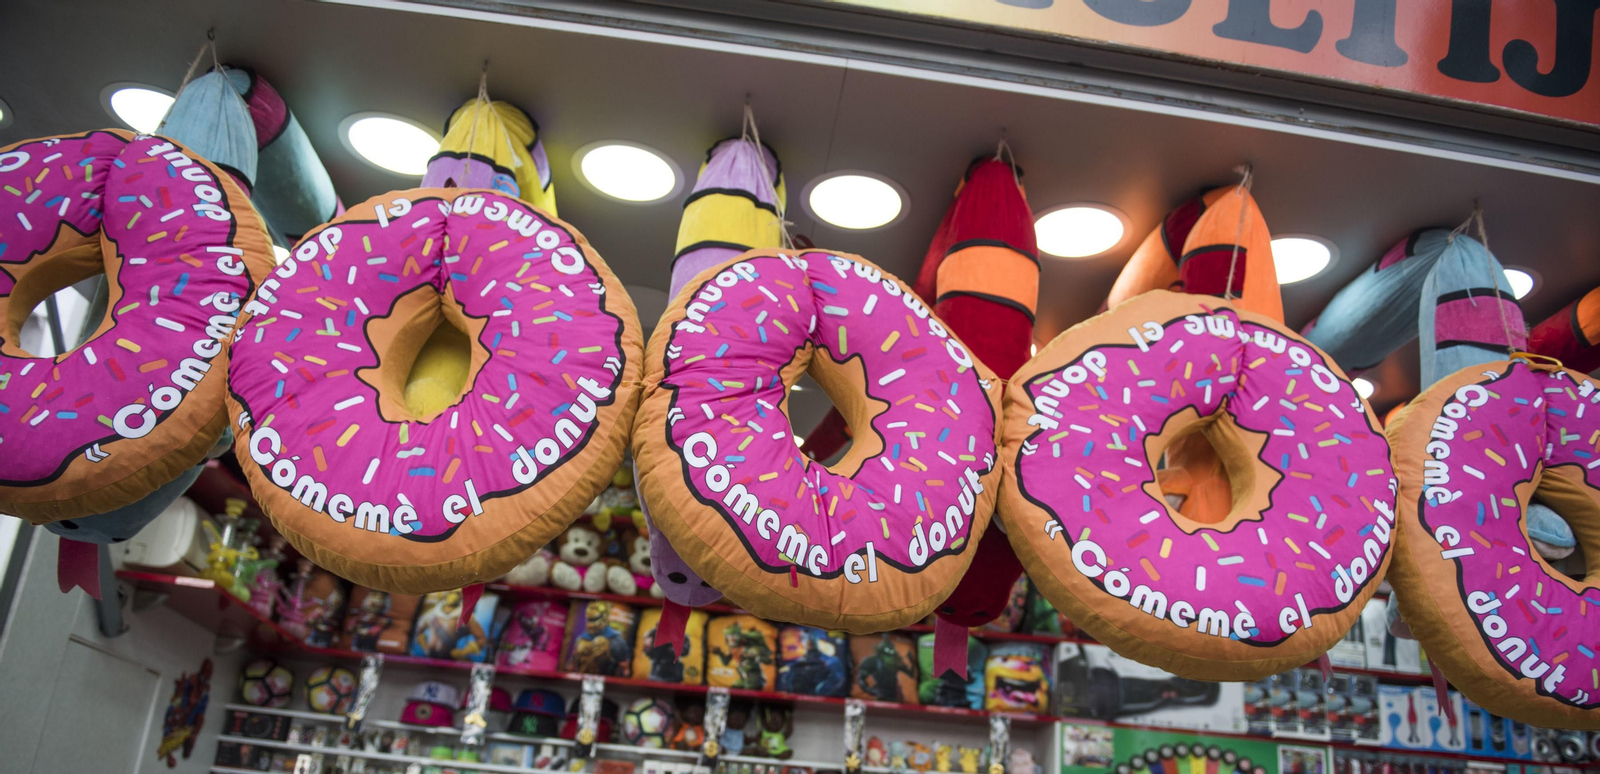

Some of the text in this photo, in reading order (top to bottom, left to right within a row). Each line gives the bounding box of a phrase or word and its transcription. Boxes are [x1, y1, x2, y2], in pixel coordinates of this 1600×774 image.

[374, 198, 412, 228] el
[206, 246, 244, 276] el
[1128, 321, 1164, 352] el
[442, 479, 484, 524] el
[1435, 525, 1475, 560] el
[843, 541, 878, 584] el
[1279, 592, 1312, 632] el
